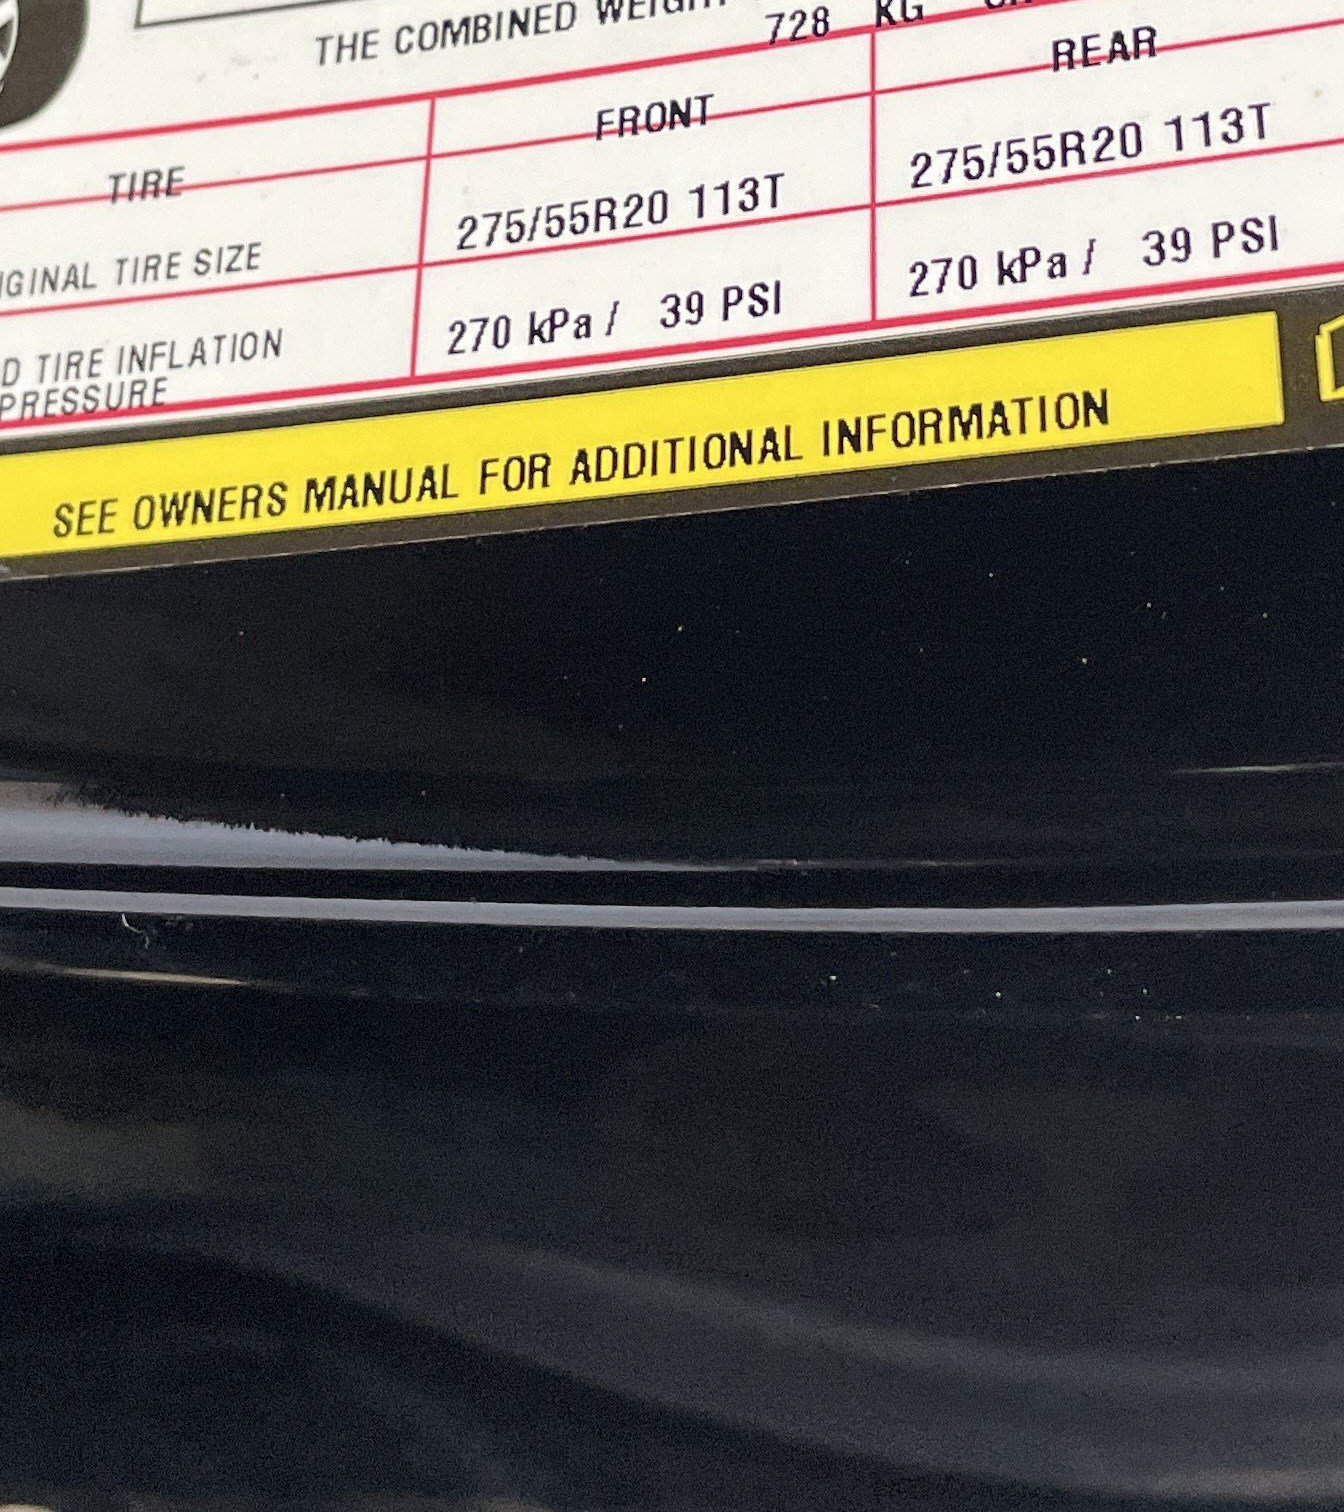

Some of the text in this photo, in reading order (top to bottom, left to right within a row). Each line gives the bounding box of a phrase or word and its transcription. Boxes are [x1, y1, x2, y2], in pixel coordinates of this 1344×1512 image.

[315, 26, 379, 67] THE
[394, 0, 577, 56] COMBINED
[764, 6, 830, 46] 728
[1051, 25, 1158, 72] REAR
[595, 93, 715, 141] FRONT
[909, 102, 1273, 190] 275/55R20 113T
[107, 166, 186, 204] TIRE
[456, 173, 784, 252] 275/55R20 113T
[114, 250, 181, 287] TIRE
[194, 241, 262, 278] SIZE
[909, 215, 1279, 298] 270 kPa / 39 PSI
[447, 281, 783, 356] 270 kPa / 39 PSI
[36, 346, 105, 383] TIRE
[116, 328, 283, 379] INFLATION
[52, 388, 1111, 539] SEE OWNERS MANUAL FOR ADDITIONAL INFORMATION
